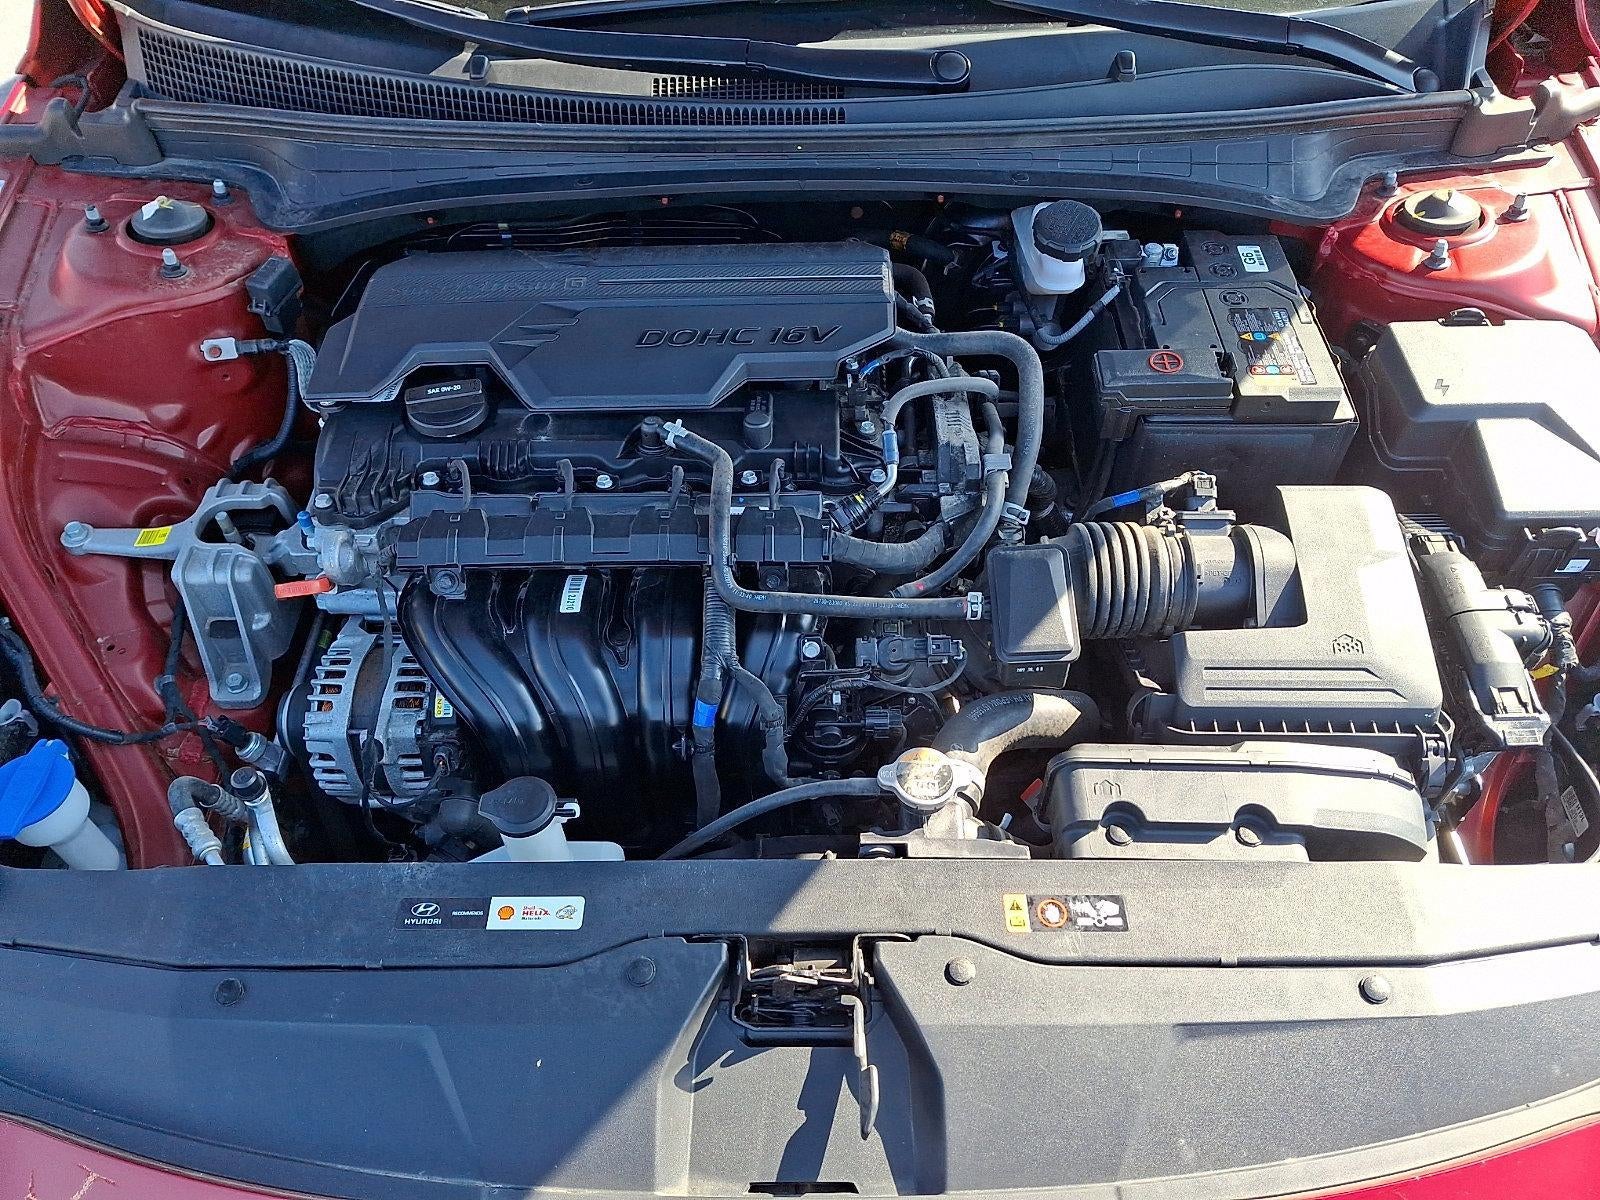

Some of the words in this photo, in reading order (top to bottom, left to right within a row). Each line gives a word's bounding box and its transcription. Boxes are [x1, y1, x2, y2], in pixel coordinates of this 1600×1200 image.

[1243, 252, 1257, 265] G6
[635, 326, 761, 348] DOHC
[769, 325, 843, 345] 16V
[427, 387, 440, 395] SAE
